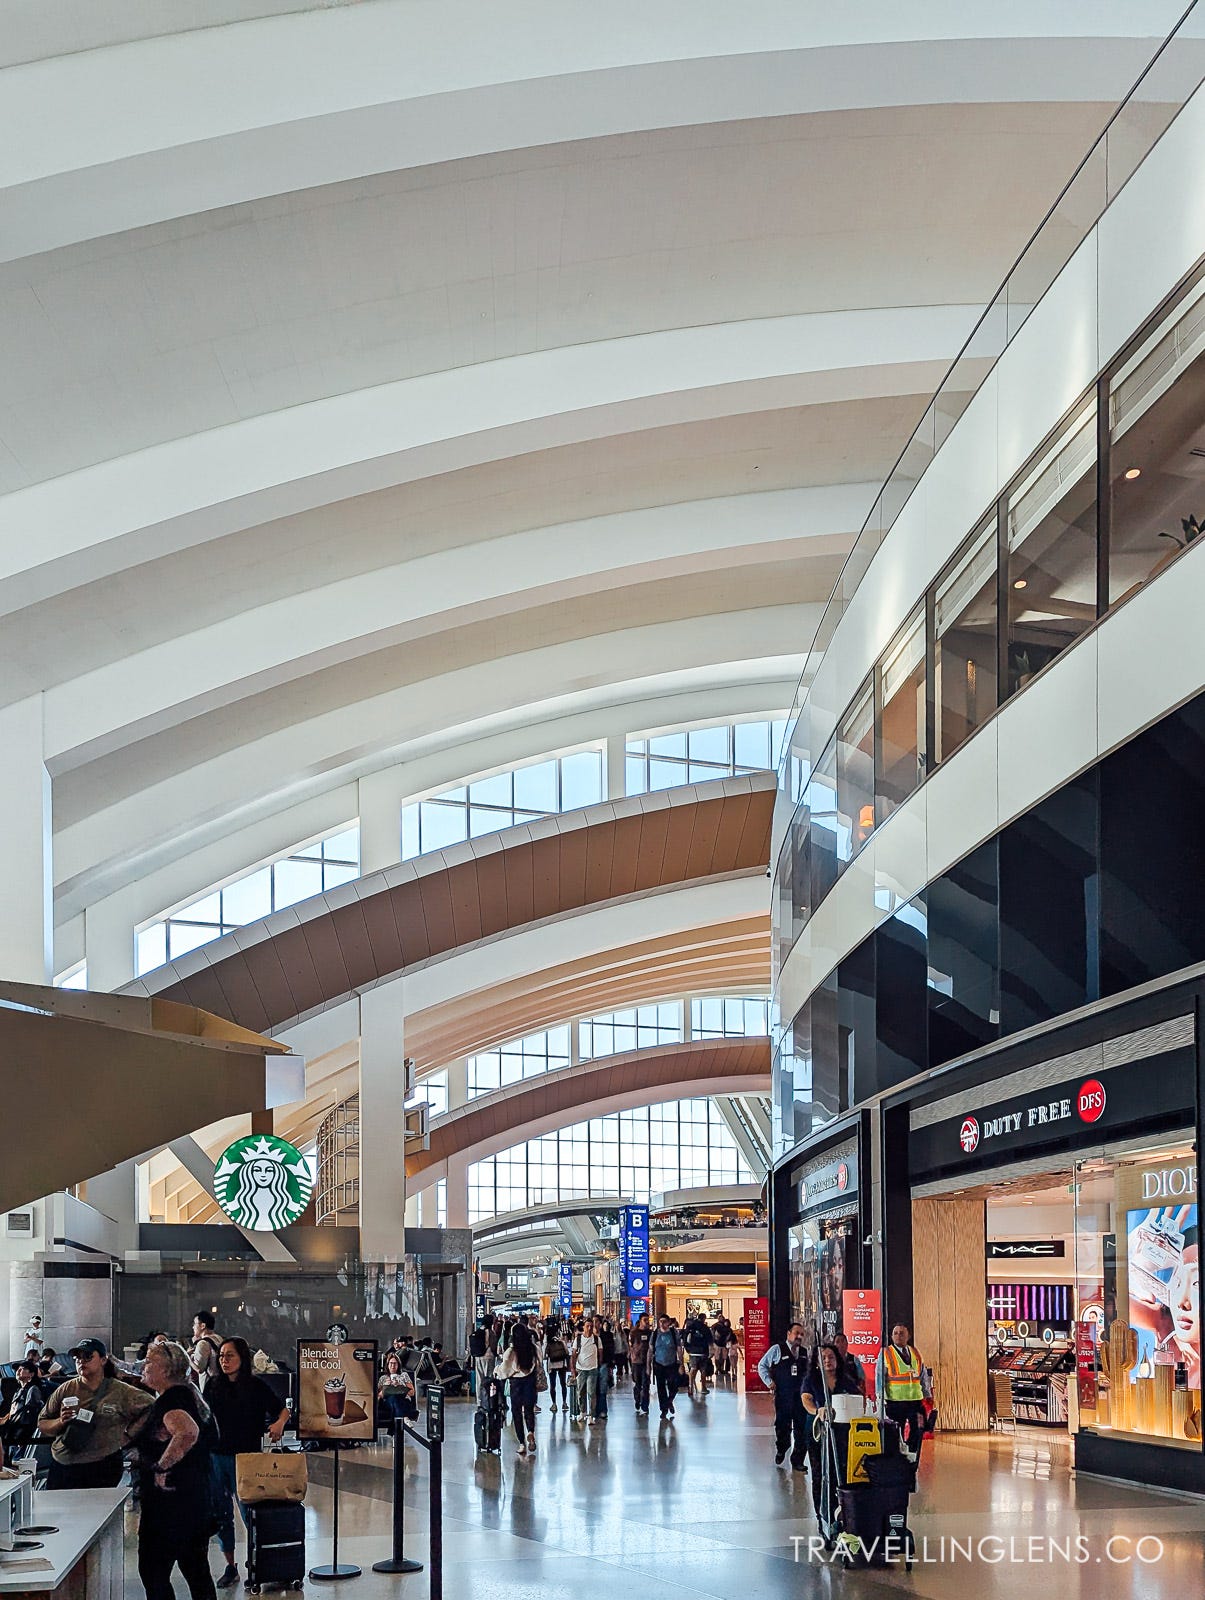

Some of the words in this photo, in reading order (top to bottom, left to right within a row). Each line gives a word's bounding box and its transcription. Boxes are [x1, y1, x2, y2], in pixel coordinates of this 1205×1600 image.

[1079, 1091, 1102, 1112] DFS
[983, 1111, 1023, 1139] DUTY
[1027, 1099, 1072, 1127] FREE
[632, 1214, 643, 1228] B
[650, 1265, 662, 1273] OF
[664, 1265, 685, 1273] TIME
[476, 1304, 485, 1319] 148
[846, 1336, 880, 1345] US$29
[301, 1348, 339, 1358] Blended
[301, 1360, 319, 1369] and
[320, 1360, 341, 1369] Cool
